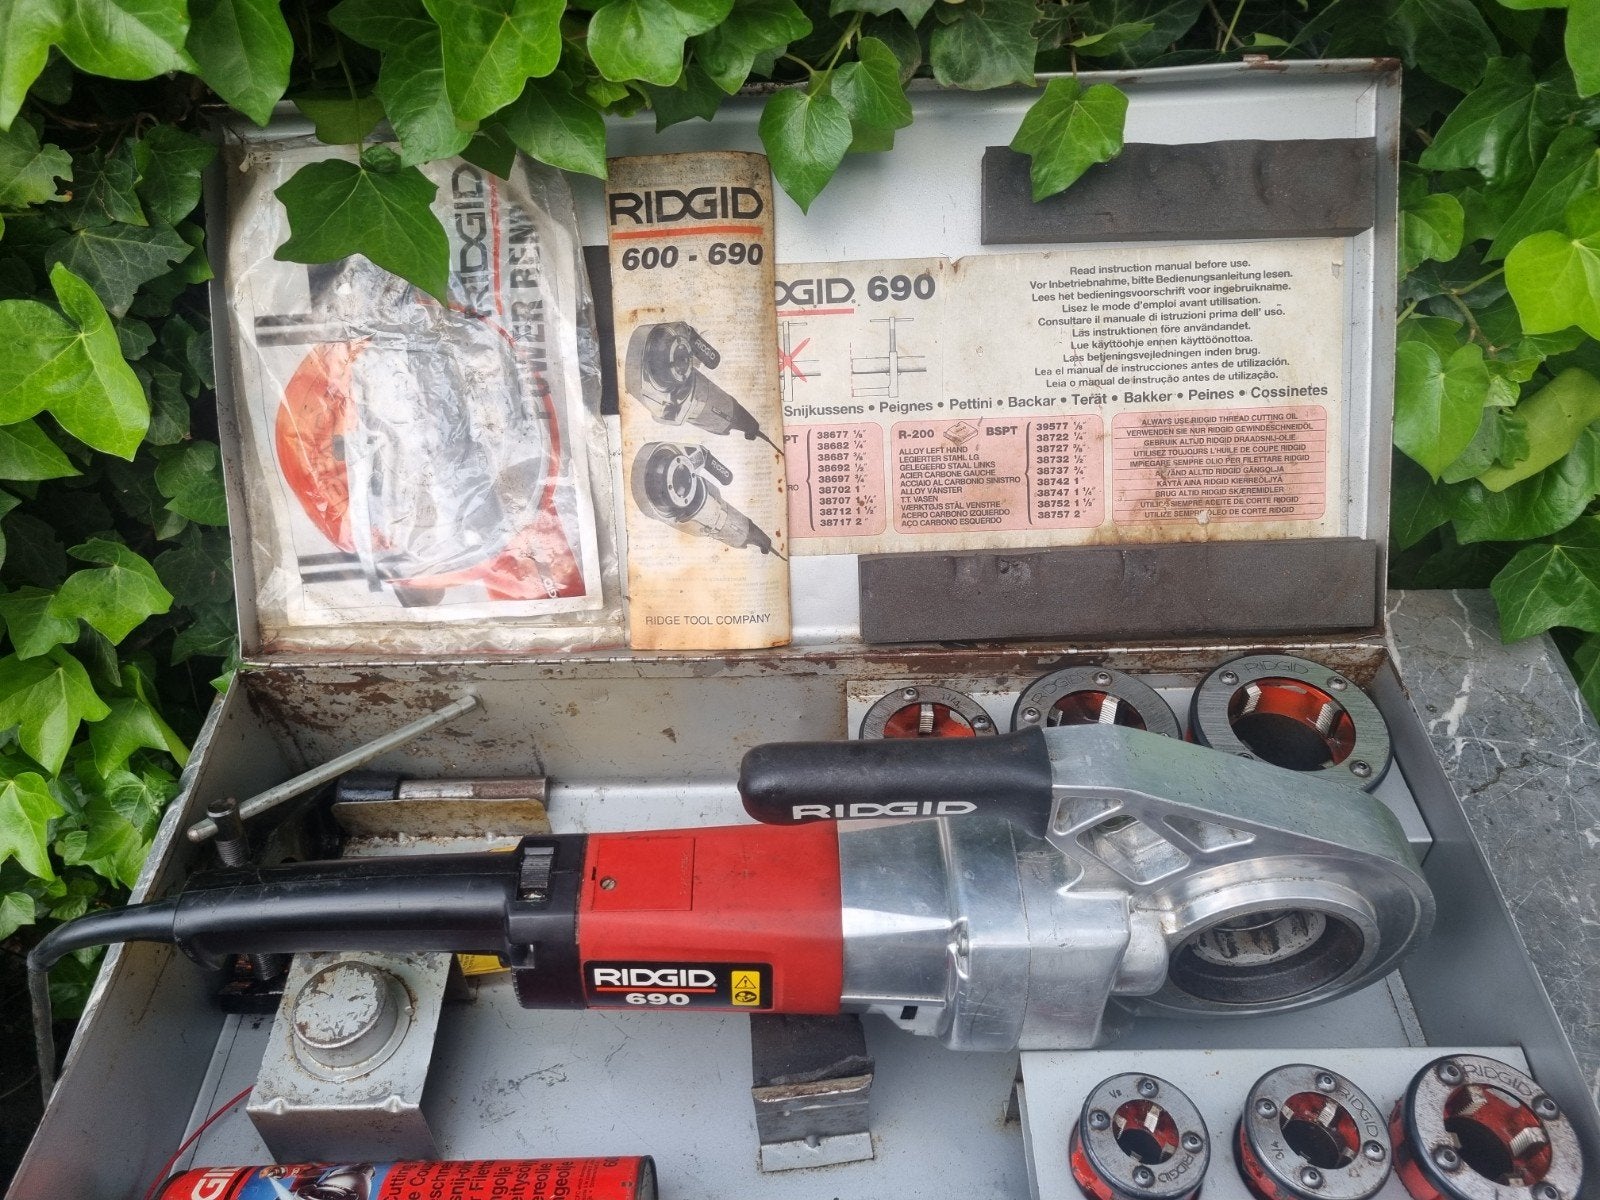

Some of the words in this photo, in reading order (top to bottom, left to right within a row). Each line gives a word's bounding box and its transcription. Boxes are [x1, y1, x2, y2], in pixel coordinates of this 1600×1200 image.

[609, 187, 764, 226] RIDGID
[451, 164, 492, 319] RIDGID
[622, 246, 679, 271] 600
[708, 243, 764, 266] 690
[1070, 265, 1096, 275] Read
[1098, 262, 1152, 274] instruction
[1154, 261, 1192, 271] manual
[1194, 259, 1227, 270] before
[1229, 260, 1251, 268] use.
[1030, 280, 1047, 290] Vor
[1130, 275, 1154, 285] bitte
[1155, 270, 1261, 286] Bedienungsanleitung
[1262, 268, 1293, 279] lesen.
[867, 274, 936, 302] 690
[1032, 291, 1055, 301] Lees
[1057, 291, 1074, 300] het
[1076, 286, 1185, 302] bedieningsvoorschrift
[1187, 287, 1210, 295] voor
[1062, 303, 1087, 313] Lisez
[1089, 302, 1099, 311] le
[1101, 301, 1130, 311] mode
[1178, 298, 1207, 308] avant
[1209, 295, 1261, 306] utilisation.
[1038, 314, 1092, 326] Consultare
[1094, 314, 1100, 323] il
[1102, 312, 1145, 323] manuale
[1148, 312, 1157, 321] di
[1160, 310, 1206, 321] istruzioni
[1208, 308, 1238, 321] prima
[1092, 325, 1158, 337] instruktionen
[1071, 340, 1089, 350] Lue
[1146, 338, 1177, 346] ennen
[1086, 348, 1201, 364] betjeningsvejledningen
[1204, 347, 1232, 357] inden
[1234, 346, 1260, 358] brug.
[1054, 366, 1064, 375] el
[1066, 364, 1103, 375] manual
[1105, 363, 1118, 373] de
[1120, 360, 1188, 372] instrucciones
[1190, 359, 1218, 369] antes
[1220, 358, 1234, 368] de
[1077, 376, 1115, 386] manual
[1117, 376, 1130, 385] de
[1181, 372, 1210, 382] antes
[1212, 372, 1225, 381] de
[783, 403, 864, 420] Snijkussens
[879, 400, 933, 416] Peignes
[949, 398, 993, 410] Pettini
[1008, 395, 1057, 408] Backar
[1124, 391, 1173, 404] Bakker
[1188, 388, 1235, 401] Peines
[1250, 385, 1328, 399] Cossinetes
[1036, 422, 1068, 431] 39577
[817, 430, 849, 439] 38677
[898, 429, 935, 440] R-200
[986, 426, 1018, 436] BSPT
[1036, 433, 1069, 442] 38722
[817, 442, 850, 450] 38682
[899, 447, 924, 455] ALLOY
[925, 446, 944, 454] LEFT
[945, 445, 968, 453] HAND
[1036, 444, 1069, 453] 38727
[817, 453, 850, 462] 38687
[900, 454, 941, 463] LEGIERTER
[942, 454, 967, 462] STAHL
[1036, 456, 1069, 464] 38732
[818, 464, 850, 472] 38692
[900, 462, 946, 471] GELEGEERD
[947, 461, 971, 469] STAAL
[972, 460, 996, 468] LINKS
[1036, 466, 1070, 476] 38737
[818, 475, 850, 484] 38697
[900, 471, 923, 479] ACIER
[924, 470, 962, 478] CARBONE
[962, 468, 996, 477] GAUCHE
[900, 479, 931, 487] ACCIAIO
[932, 478, 943, 486] AL
[943, 477, 984, 486] CARBONIO
[985, 476, 1020, 484] SINISTRO
[1037, 478, 1070, 486] 38742
[818, 486, 851, 494] 38702
[1037, 489, 1070, 497] 38747
[819, 496, 851, 505] 38707
[1037, 500, 1070, 508] 38752
[819, 508, 852, 516] 38712
[1037, 511, 1070, 519] 38757
[820, 518, 852, 527] 38717
[645, 616, 680, 626] RIDGE
[684, 615, 713, 625] TOOL
[716, 613, 771, 624] COMPANY
[1243, 660, 1309, 676] RIDGID
[792, 801, 978, 820] RIDGID
[593, 968, 716, 987] RIDGID
[625, 993, 690, 1006] 690
[1462, 1064, 1533, 1096] RIDGID
[1338, 1086, 1379, 1138] RIDGID
[1157, 1153, 1196, 1184] RIDGID
